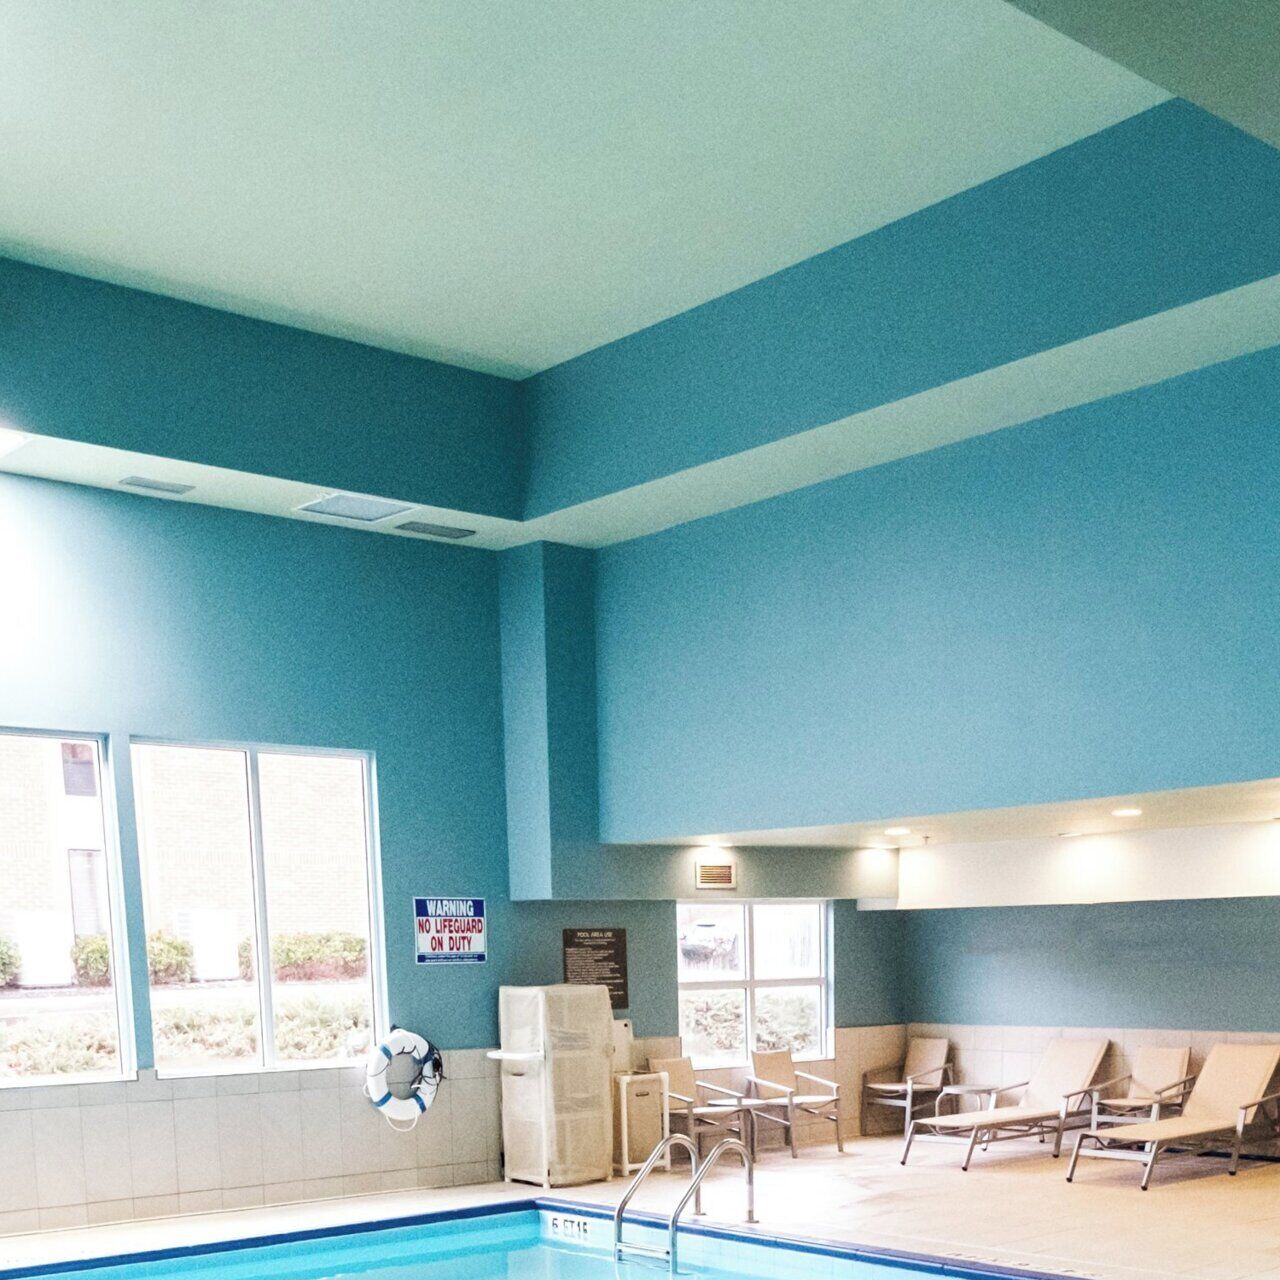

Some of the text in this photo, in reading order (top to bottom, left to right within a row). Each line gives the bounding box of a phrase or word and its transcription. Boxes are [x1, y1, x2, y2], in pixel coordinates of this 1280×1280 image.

[426, 899, 474, 916] WARNING
[418, 918, 483, 934] NO LIFEGUARD
[431, 936, 472, 951] ON DUTY
